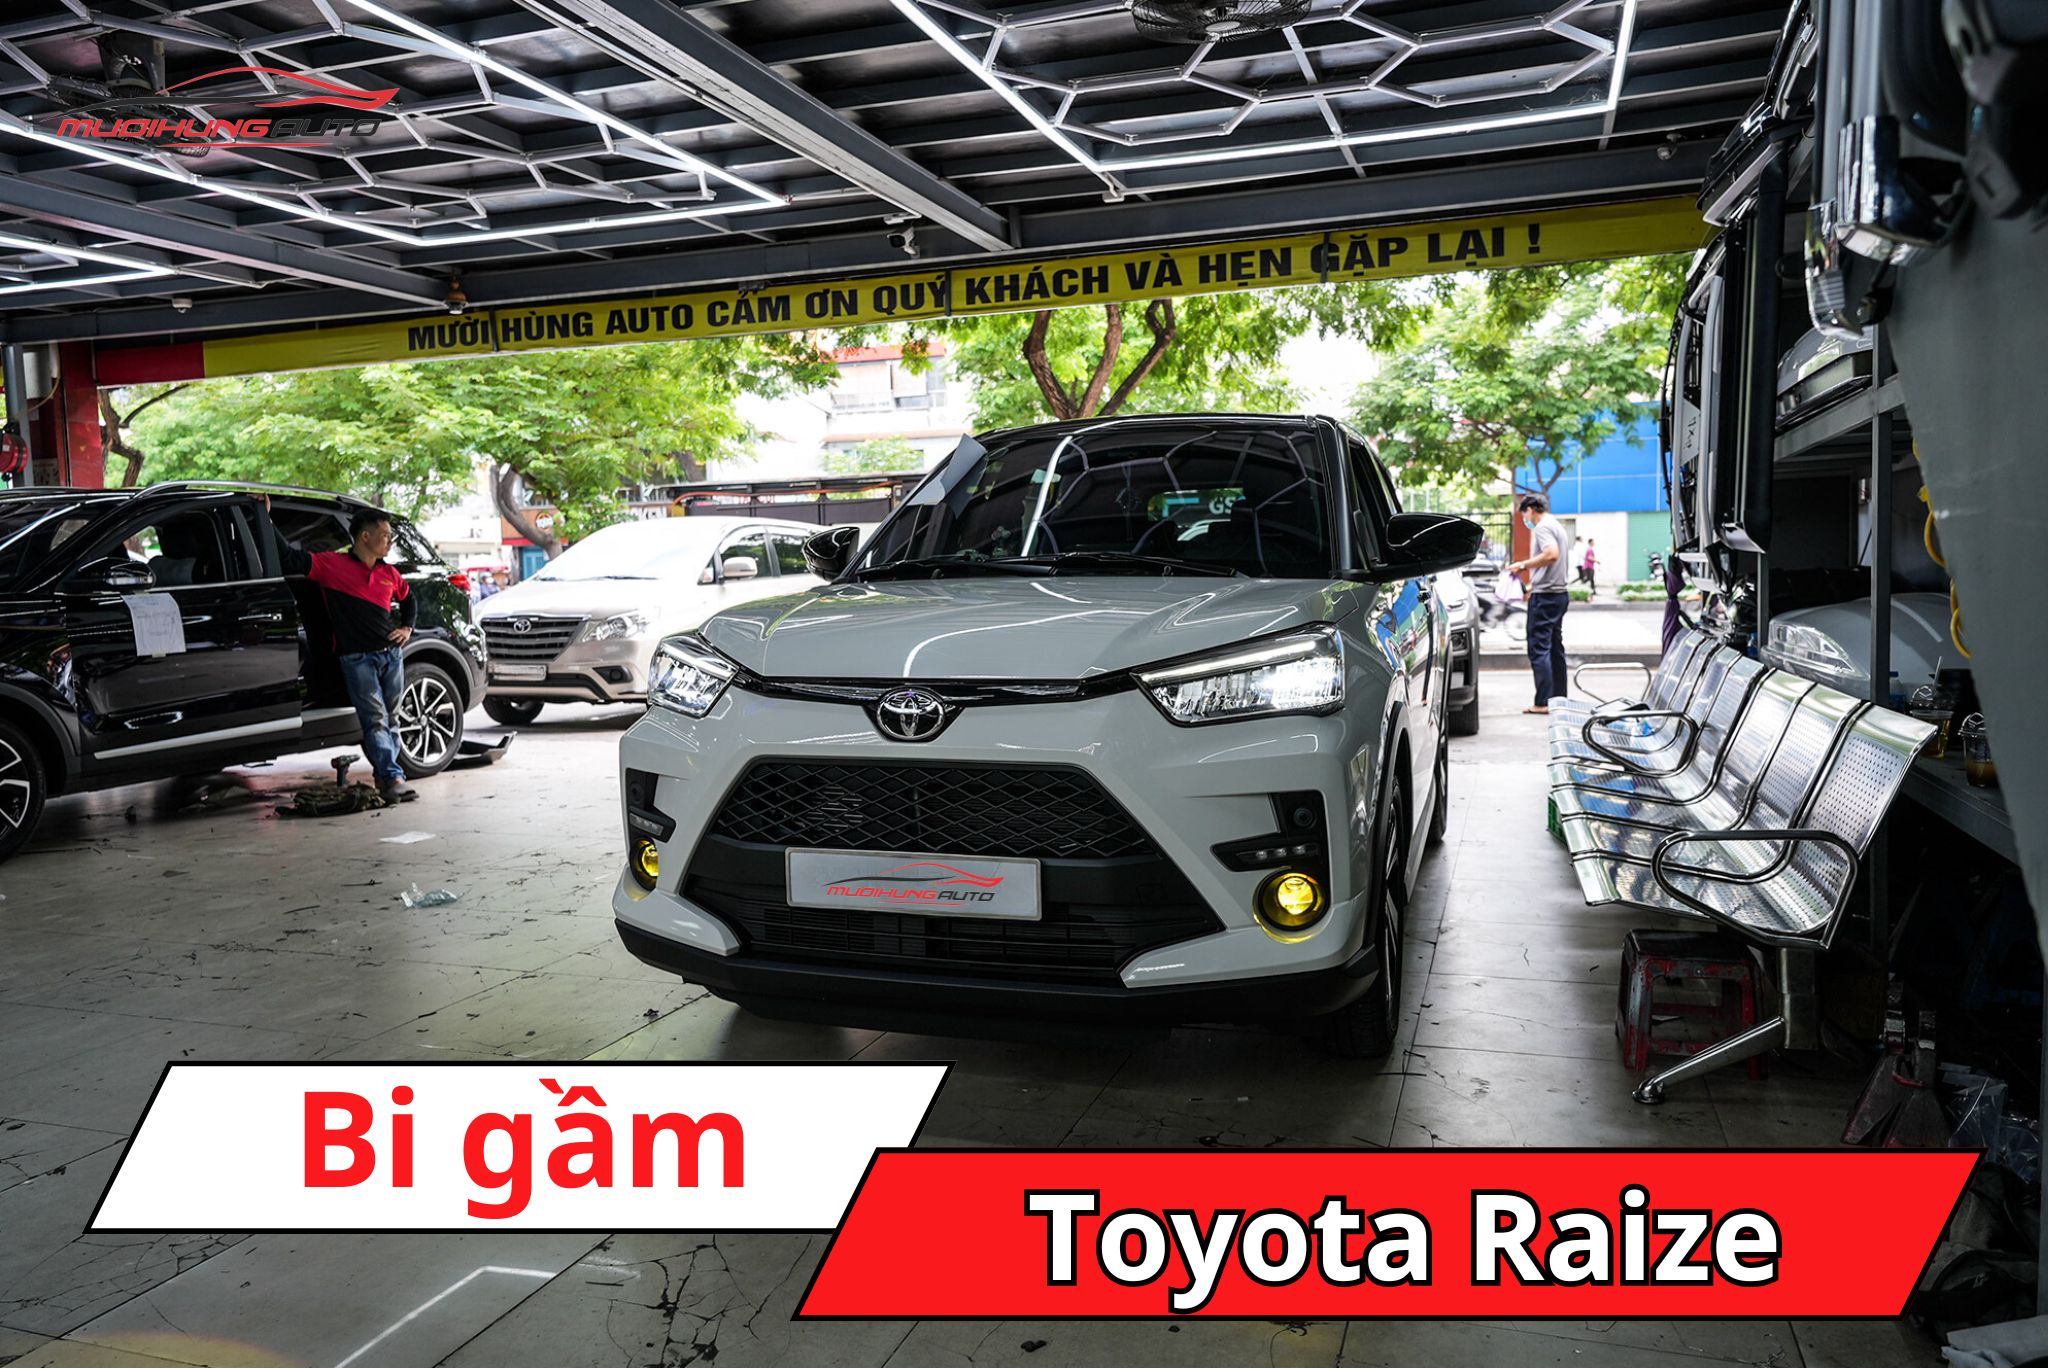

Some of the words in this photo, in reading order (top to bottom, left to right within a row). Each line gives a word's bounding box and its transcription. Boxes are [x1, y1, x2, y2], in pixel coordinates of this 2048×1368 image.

[407, 315, 491, 351] MƯỜI
[502, 311, 594, 343] HÙNG
[605, 303, 694, 335] AUTO
[805, 288, 858, 319] ƠN
[873, 274, 946, 316] QUÝ
[965, 264, 1109, 306] KHÁCH
[1124, 252, 1183, 291] VÀ
[1198, 246, 1292, 287] HẸN
[1310, 232, 1408, 277] GẶP
[1427, 226, 1505, 267] LẠI
[1527, 223, 1541, 255] !
